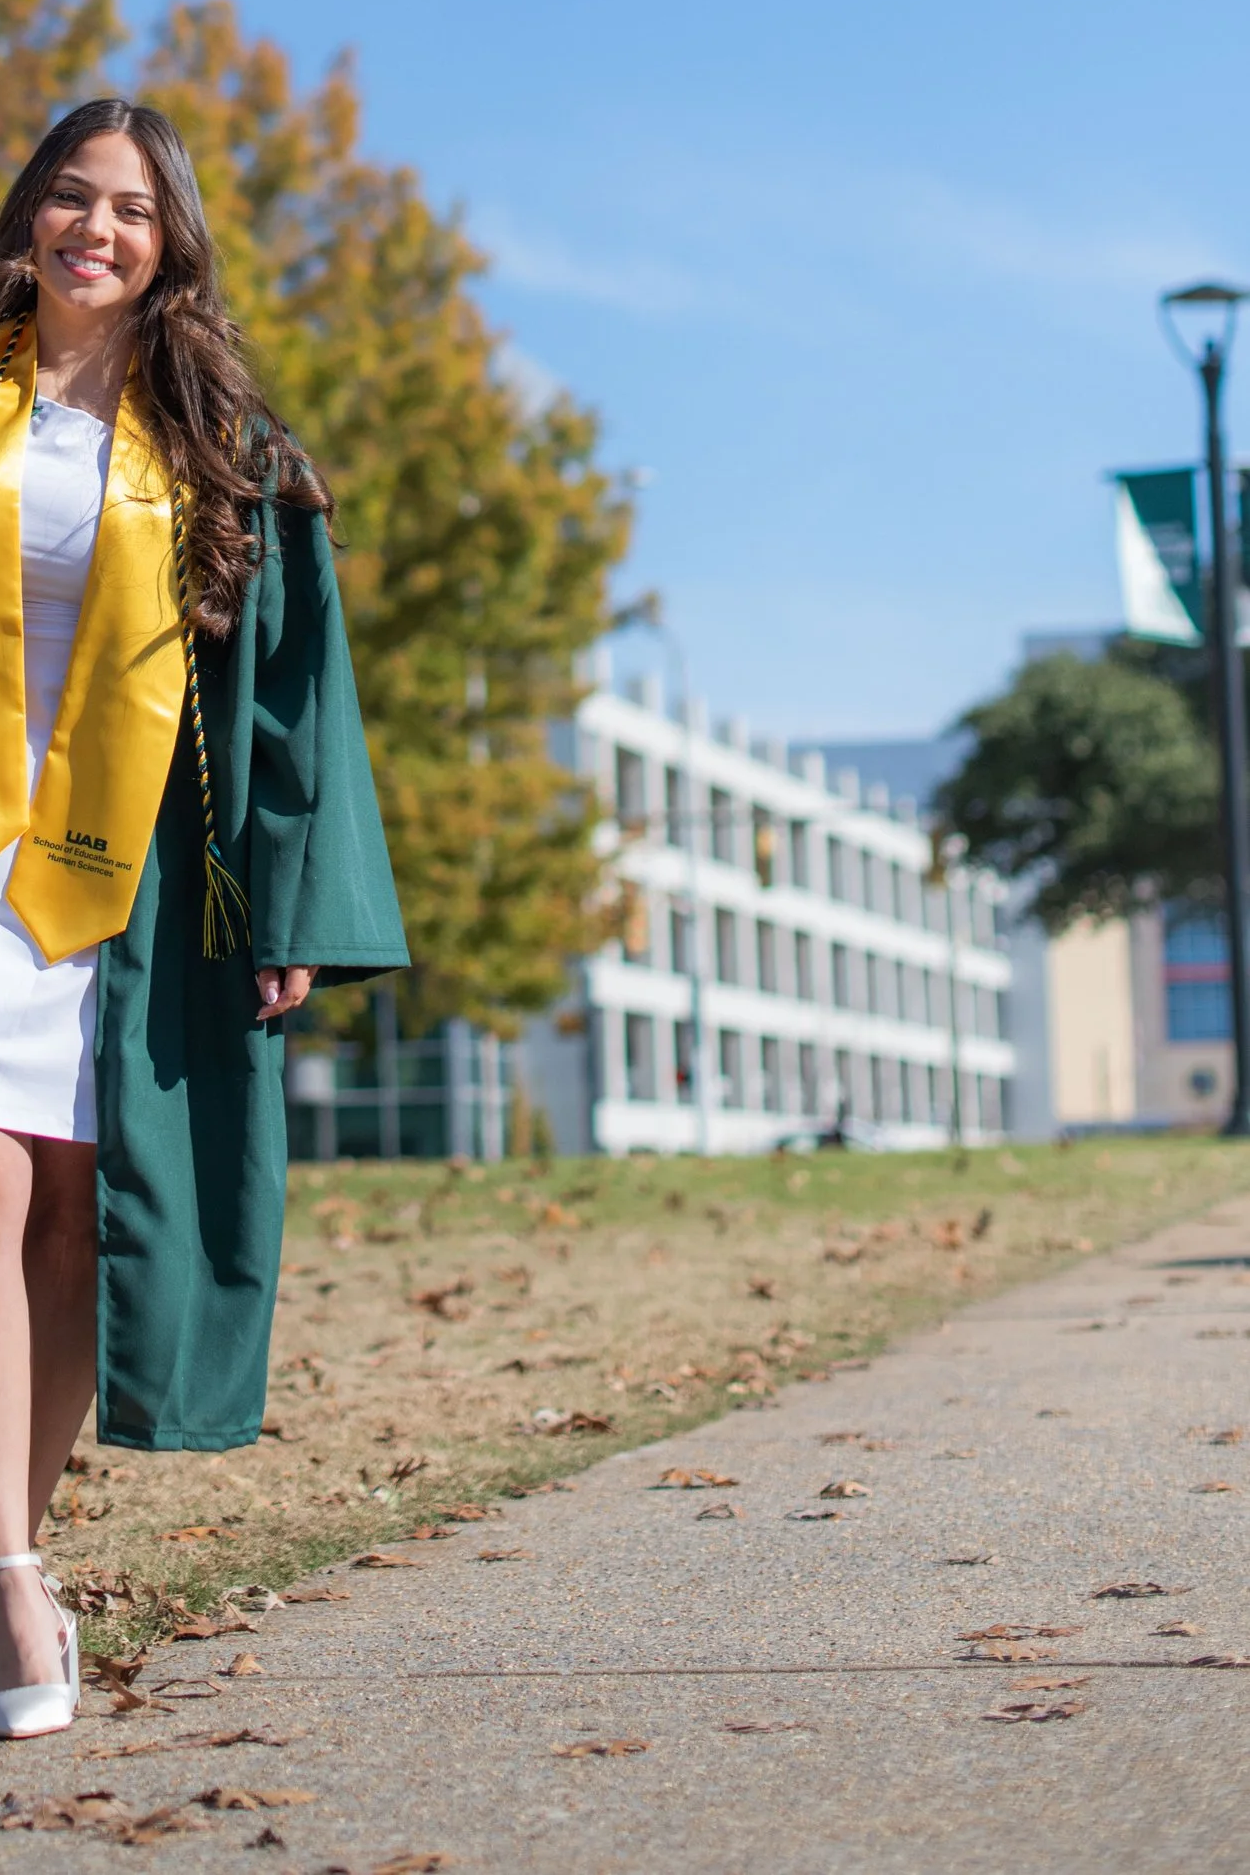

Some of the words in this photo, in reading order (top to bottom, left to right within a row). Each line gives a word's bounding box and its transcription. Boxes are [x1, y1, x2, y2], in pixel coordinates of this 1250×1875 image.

[33, 836, 63, 852] School
[64, 845, 73, 854] of
[74, 848, 115, 866] Education
[115, 861, 133, 871] and
[66, 830, 108, 852] UAB
[47, 852, 76, 867] Human
[77, 860, 114, 877] Sciences
